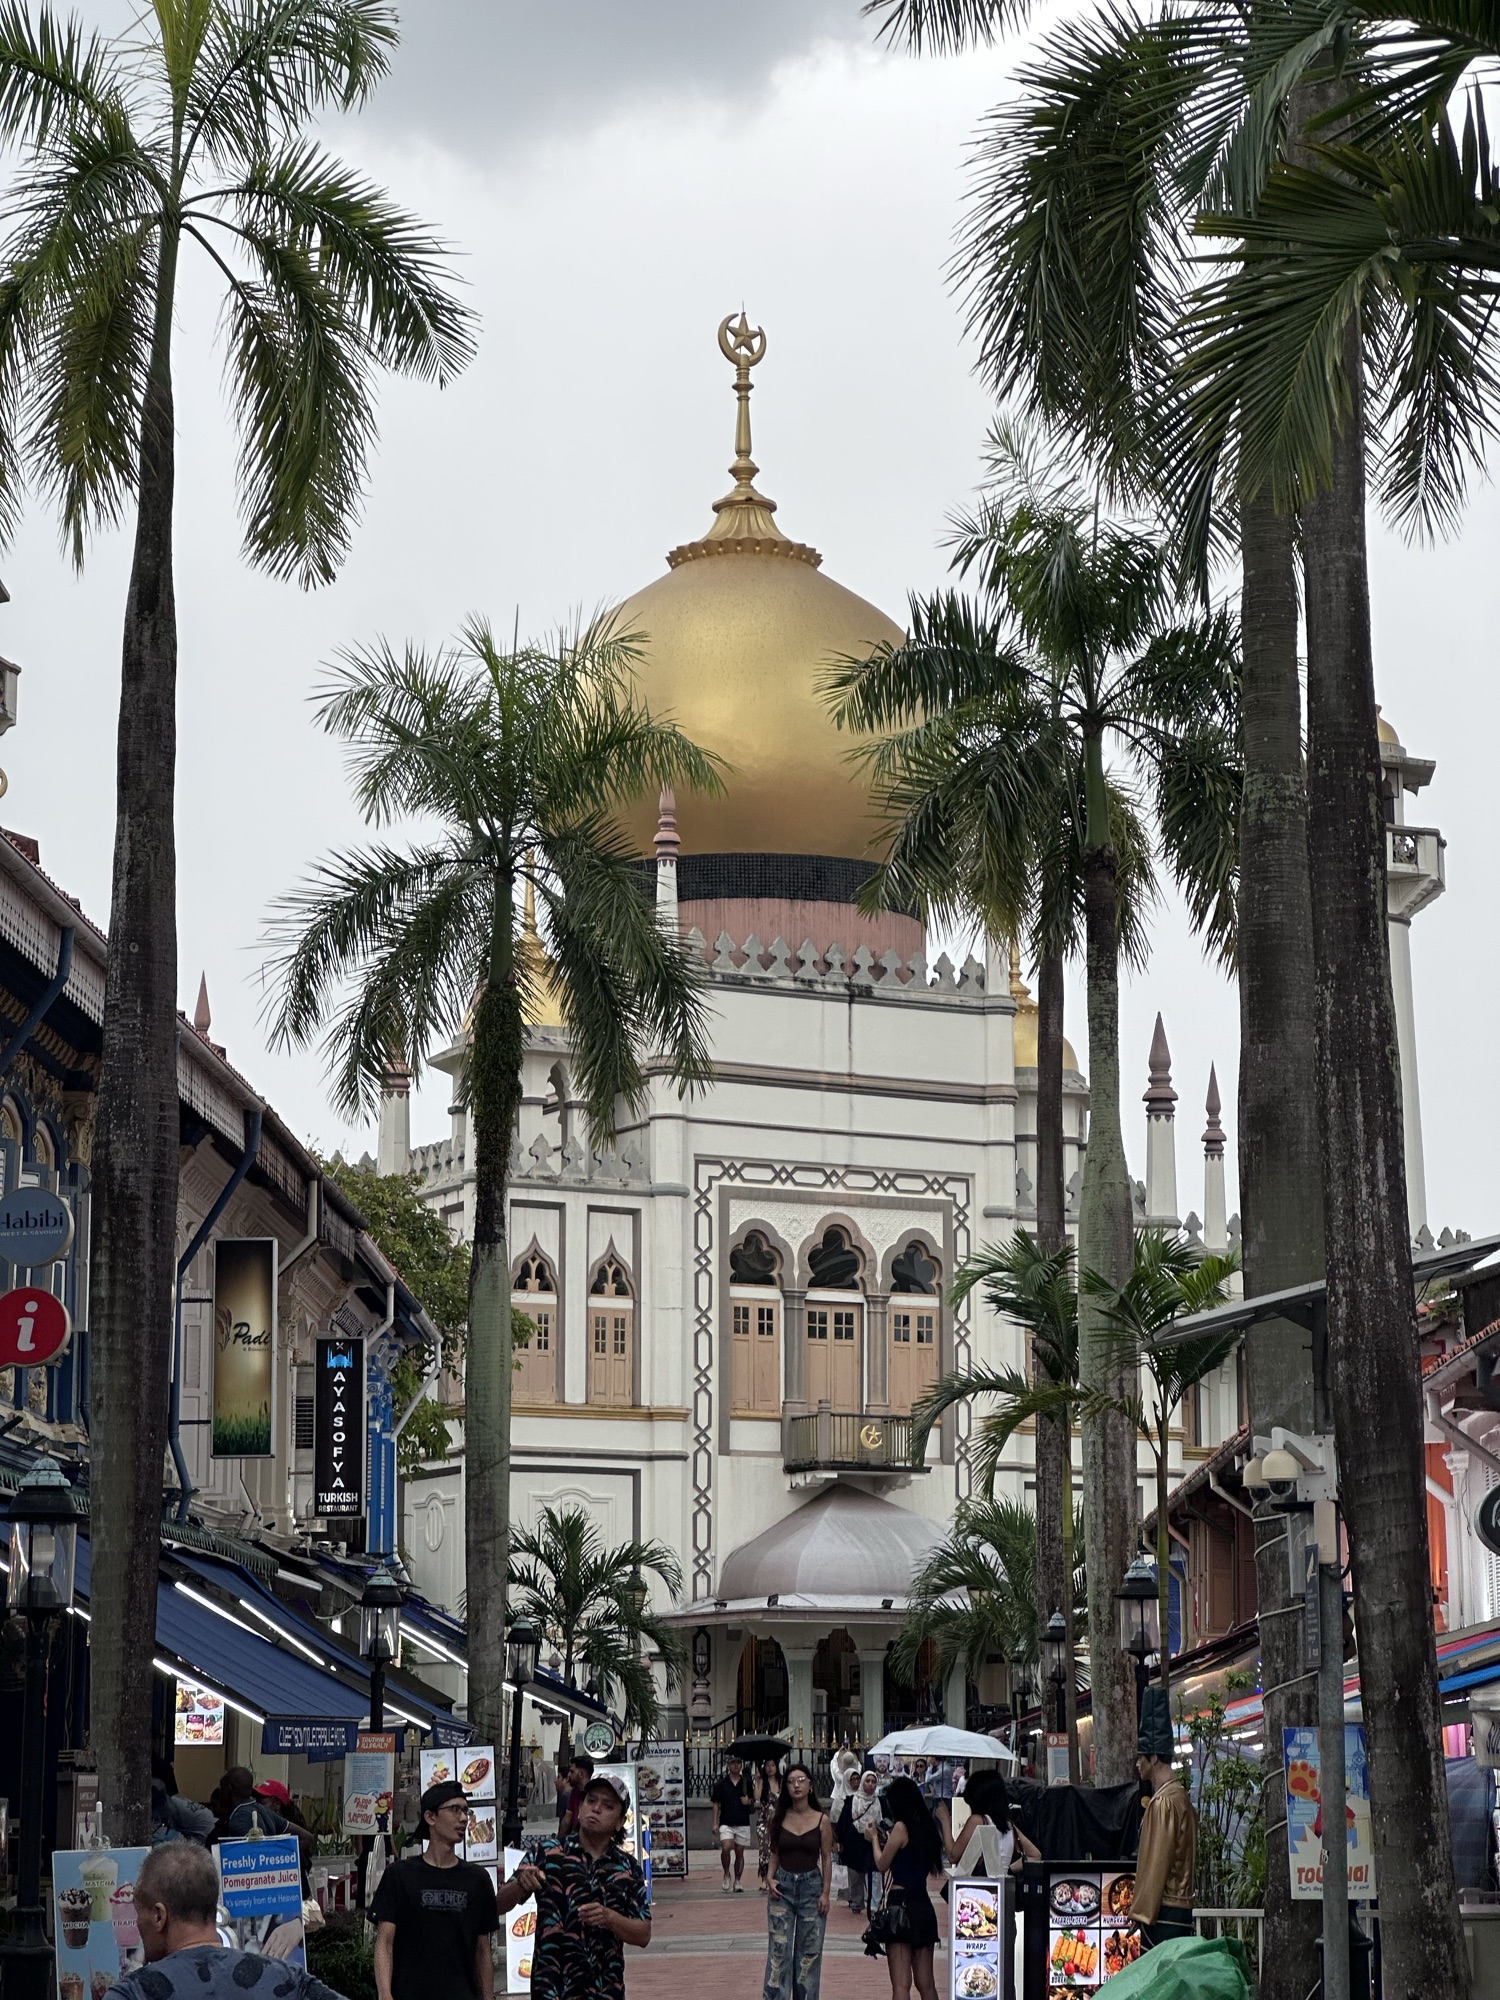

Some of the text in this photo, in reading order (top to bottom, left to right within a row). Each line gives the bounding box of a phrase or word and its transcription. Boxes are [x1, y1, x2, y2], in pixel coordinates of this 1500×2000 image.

[0, 1209, 64, 1229] Habibi
[232, 1321, 271, 1345] Padi
[332, 1370, 347, 1488] AYASOFYA
[318, 1492, 358, 1503] TURKISH
[318, 1504, 359, 1513] RESTAURANT
[222, 1852, 297, 1870] Freshly Pressed
[223, 1870, 298, 1889] Pomegranate Juice
[234, 1897, 252, 1908] simply
[253, 1896, 267, 1905] from
[268, 1895, 277, 1903] the
[278, 1893, 299, 1902] Heaven
[63, 1921, 90, 1929] MOCHA
[966, 1942, 987, 1950] WRAPS
